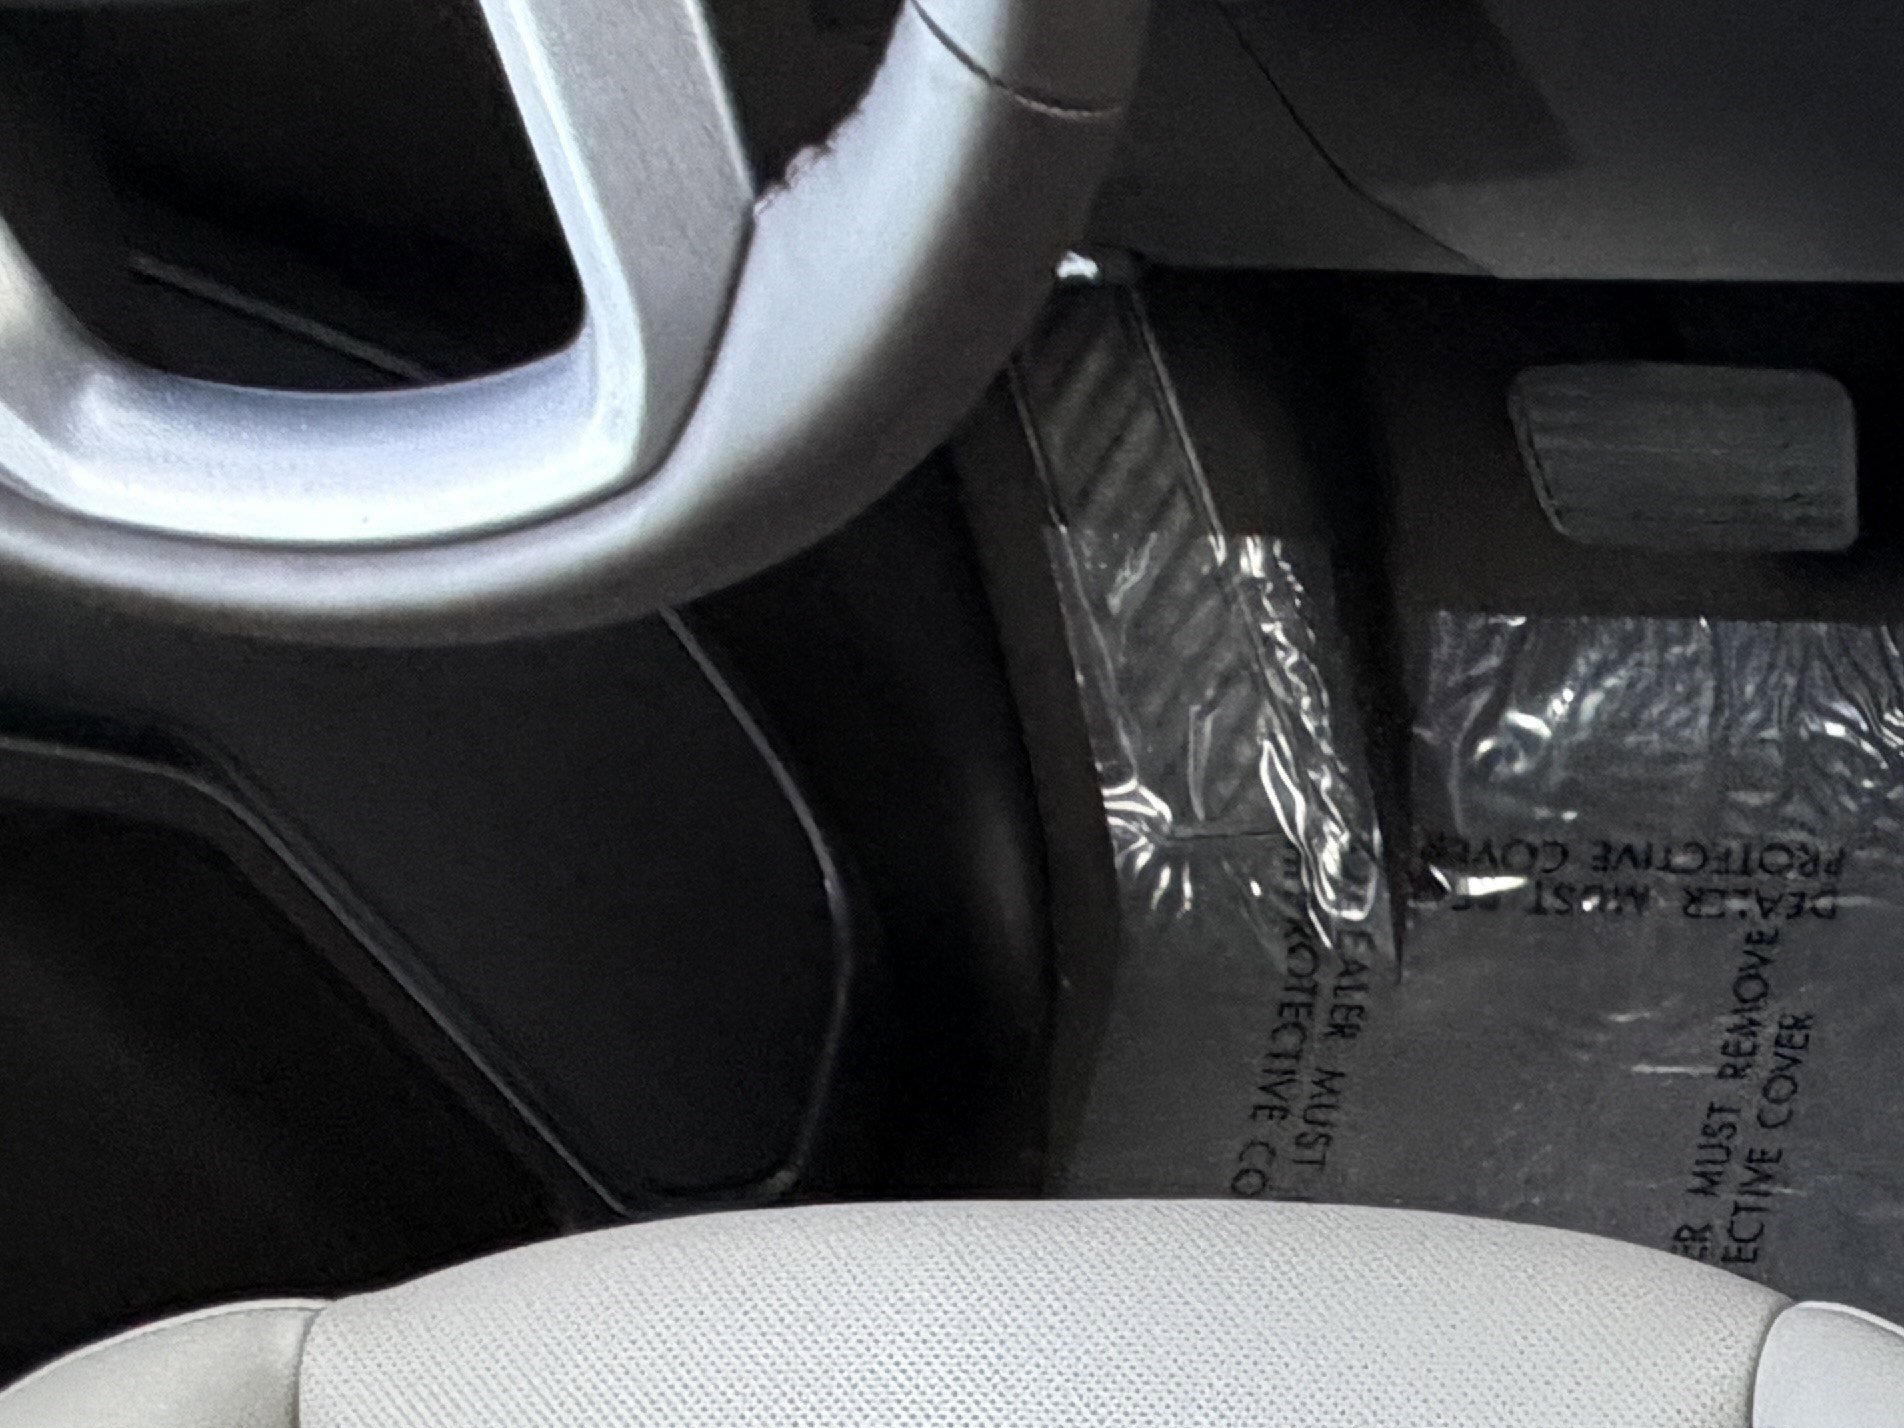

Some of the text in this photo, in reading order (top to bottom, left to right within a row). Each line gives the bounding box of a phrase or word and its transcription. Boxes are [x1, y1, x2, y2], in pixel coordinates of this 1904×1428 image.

[1290, 1066, 1346, 1171] MUST
[1685, 1101, 1742, 1197] MUST
[1715, 927, 1780, 1081] REMOVE
[1756, 1012, 1815, 1130] COVER
